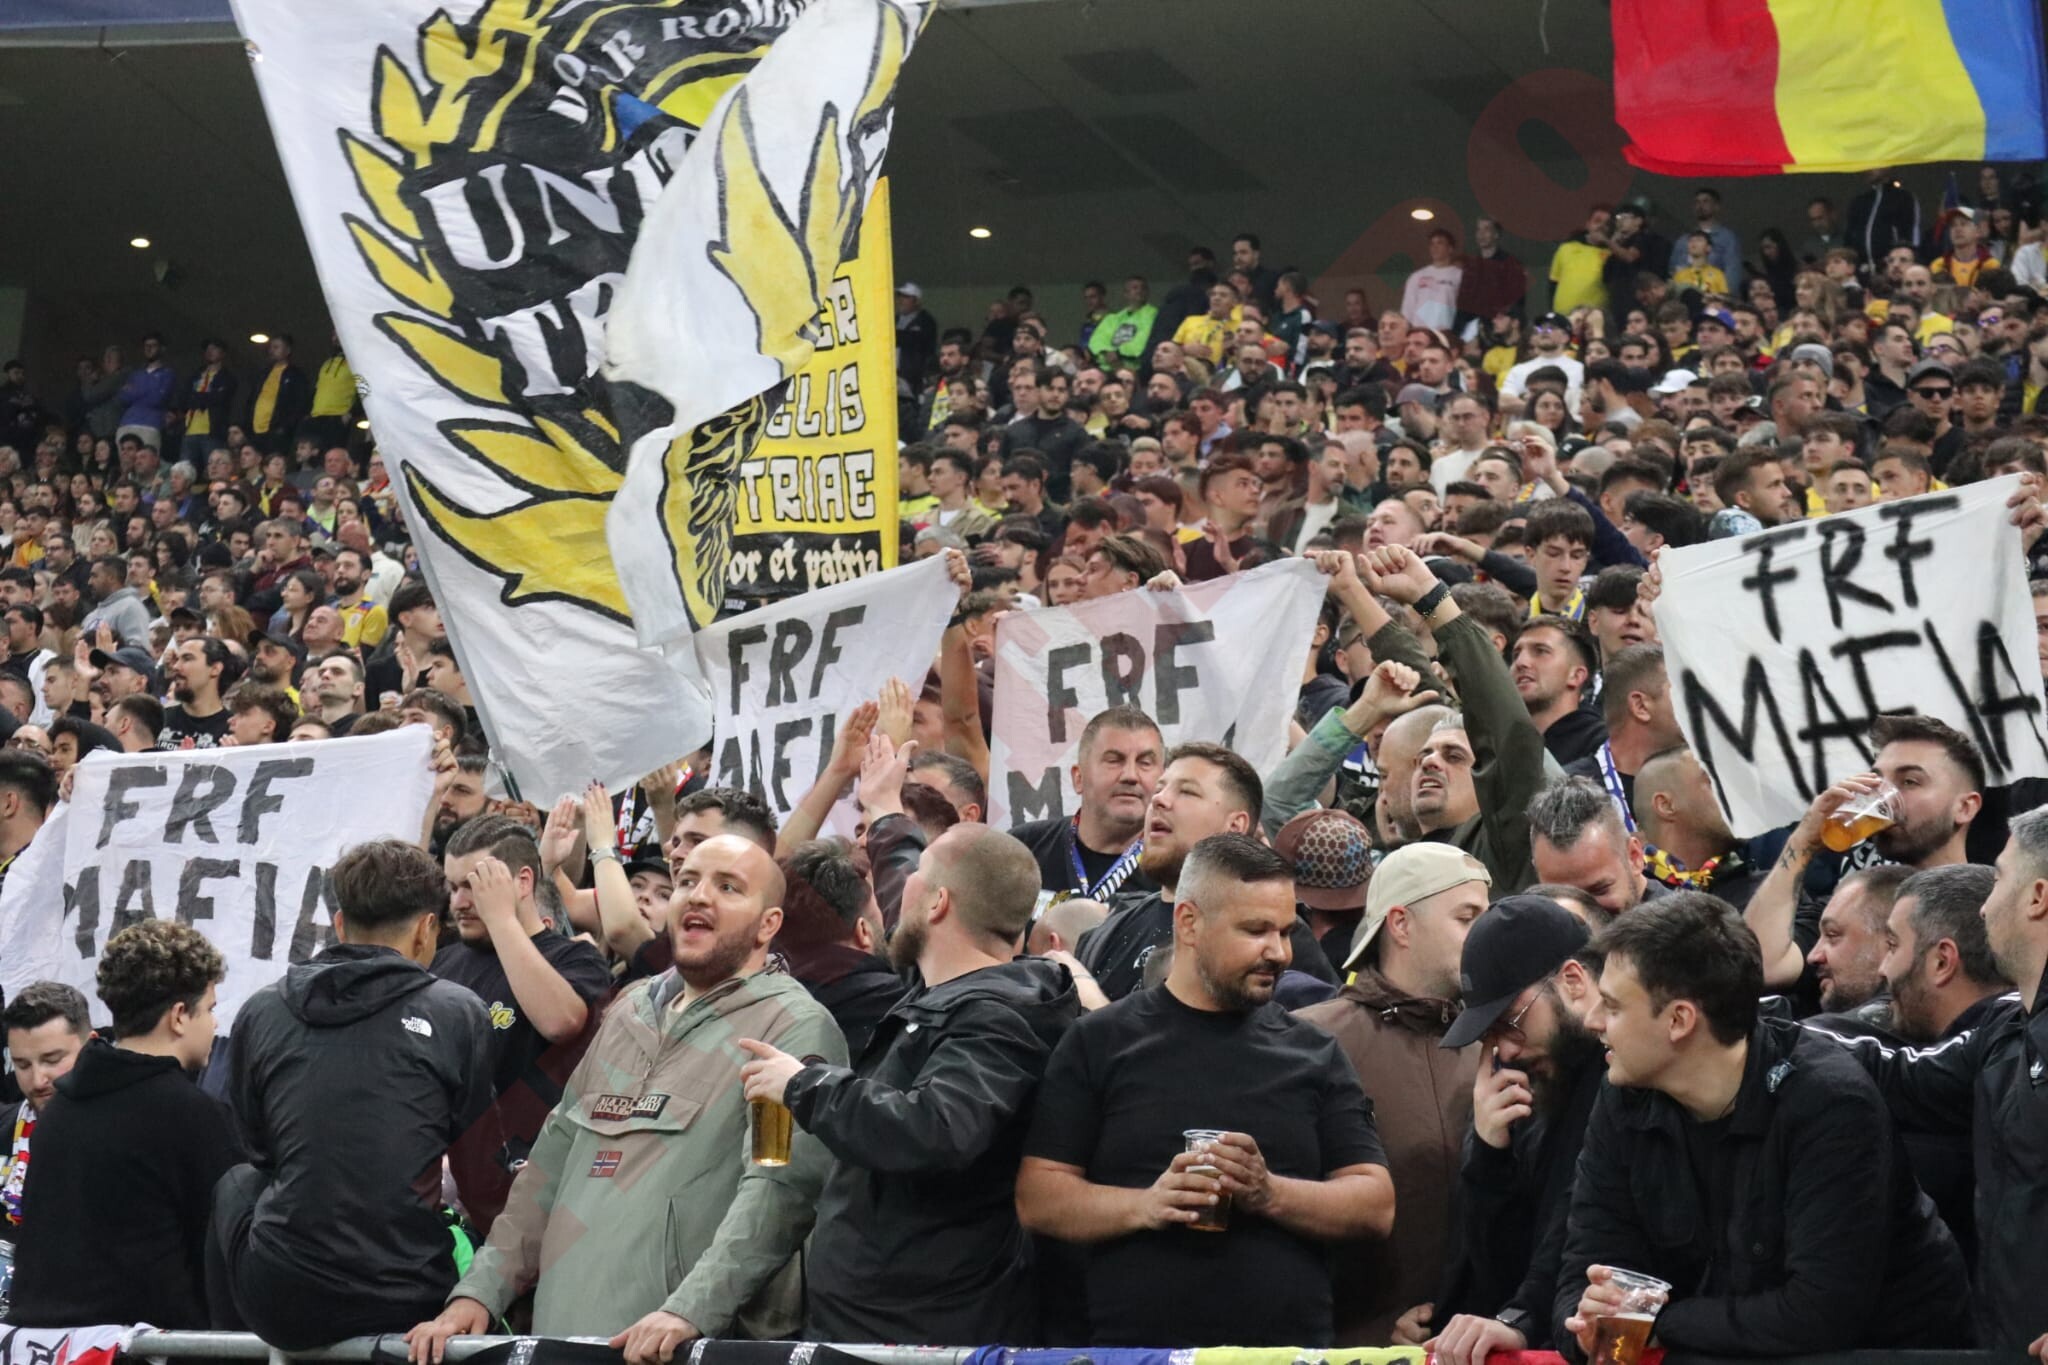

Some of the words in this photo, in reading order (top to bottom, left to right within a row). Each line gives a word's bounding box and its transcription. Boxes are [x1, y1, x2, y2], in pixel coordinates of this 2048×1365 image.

[547, 30, 646, 124] DOR
[659, 0, 806, 41] ROMA
[476, 272, 627, 397] TR
[814, 275, 861, 352] ER
[765, 361, 867, 438] ELIS
[737, 449, 876, 522] TRIAE
[727, 550, 763, 586] or
[769, 537, 798, 583] et
[803, 537, 880, 592] patria
[1742, 495, 1960, 644] FRF
[728, 604, 867, 716] FRF
[1046, 619, 1215, 744] FRF
[1681, 617, 2048, 823] MAFIA
[96, 757, 315, 850] FRF
